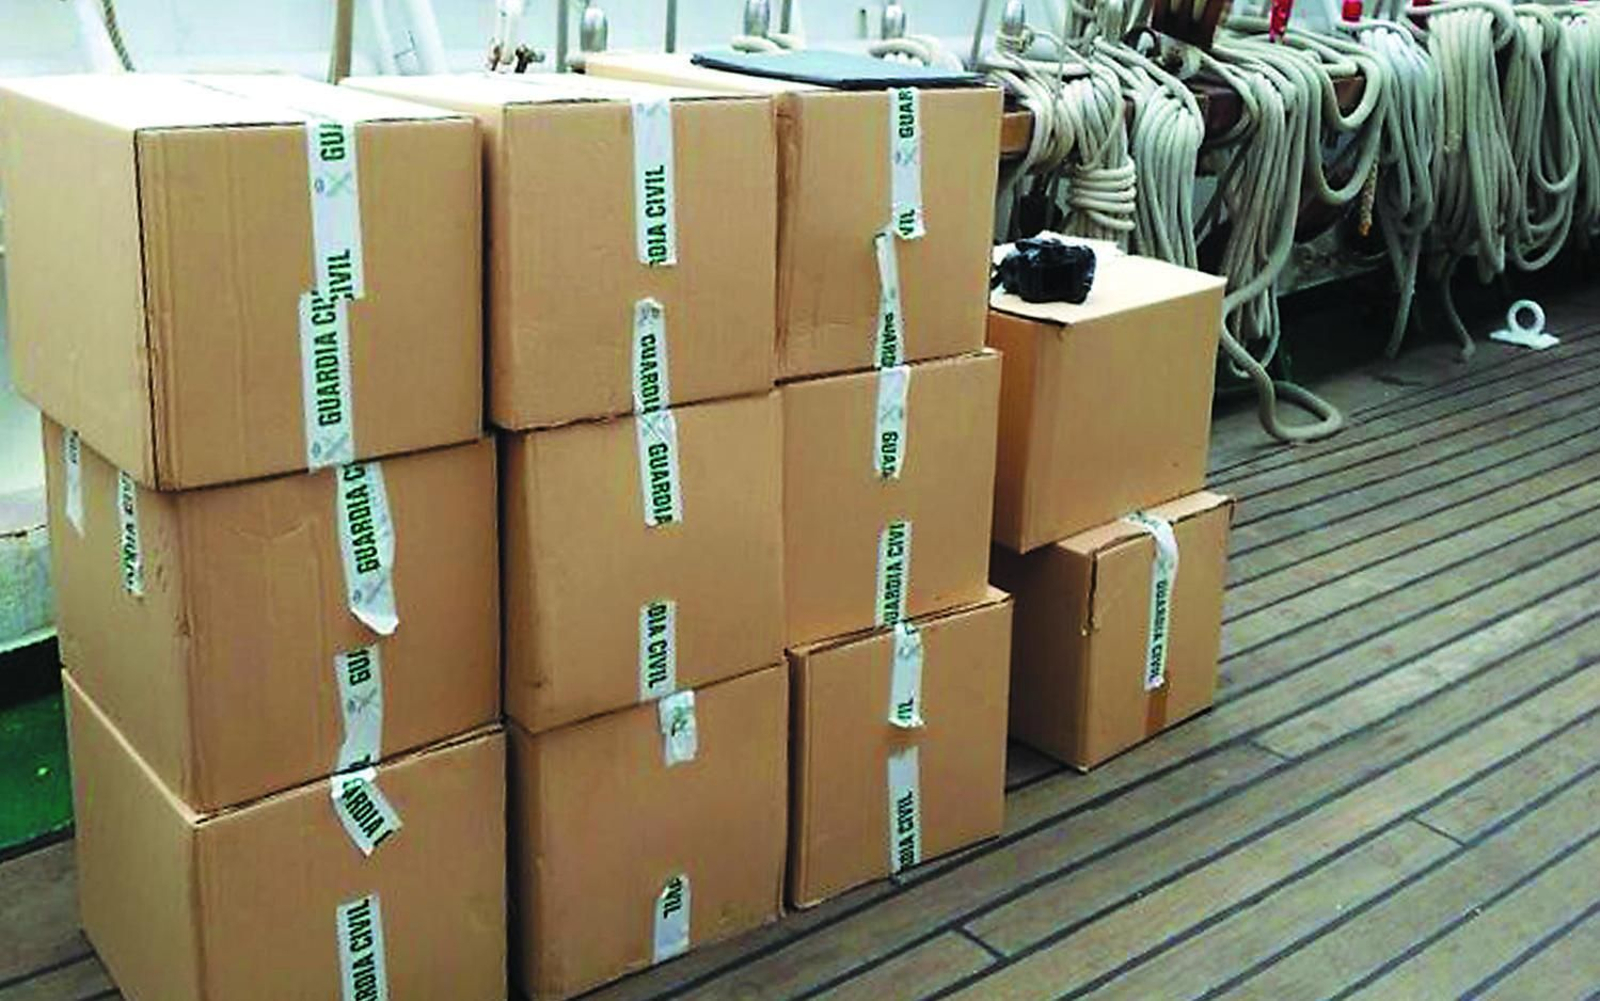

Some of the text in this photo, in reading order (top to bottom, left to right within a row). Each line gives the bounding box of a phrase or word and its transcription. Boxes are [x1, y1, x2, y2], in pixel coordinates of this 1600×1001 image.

[645, 165, 667, 219] CIVIL
[314, 331, 342, 427] GUARDIA
[641, 333, 661, 415] GUARDIA
[648, 442, 673, 526] GUARDIA
[345, 484, 382, 575] GUARDIA
[648, 602, 668, 689] DIA CIVIL
[897, 790, 914, 835] CIVIL
[663, 877, 682, 919] IVIL
[346, 898, 379, 1001] RDIA CIVIL
